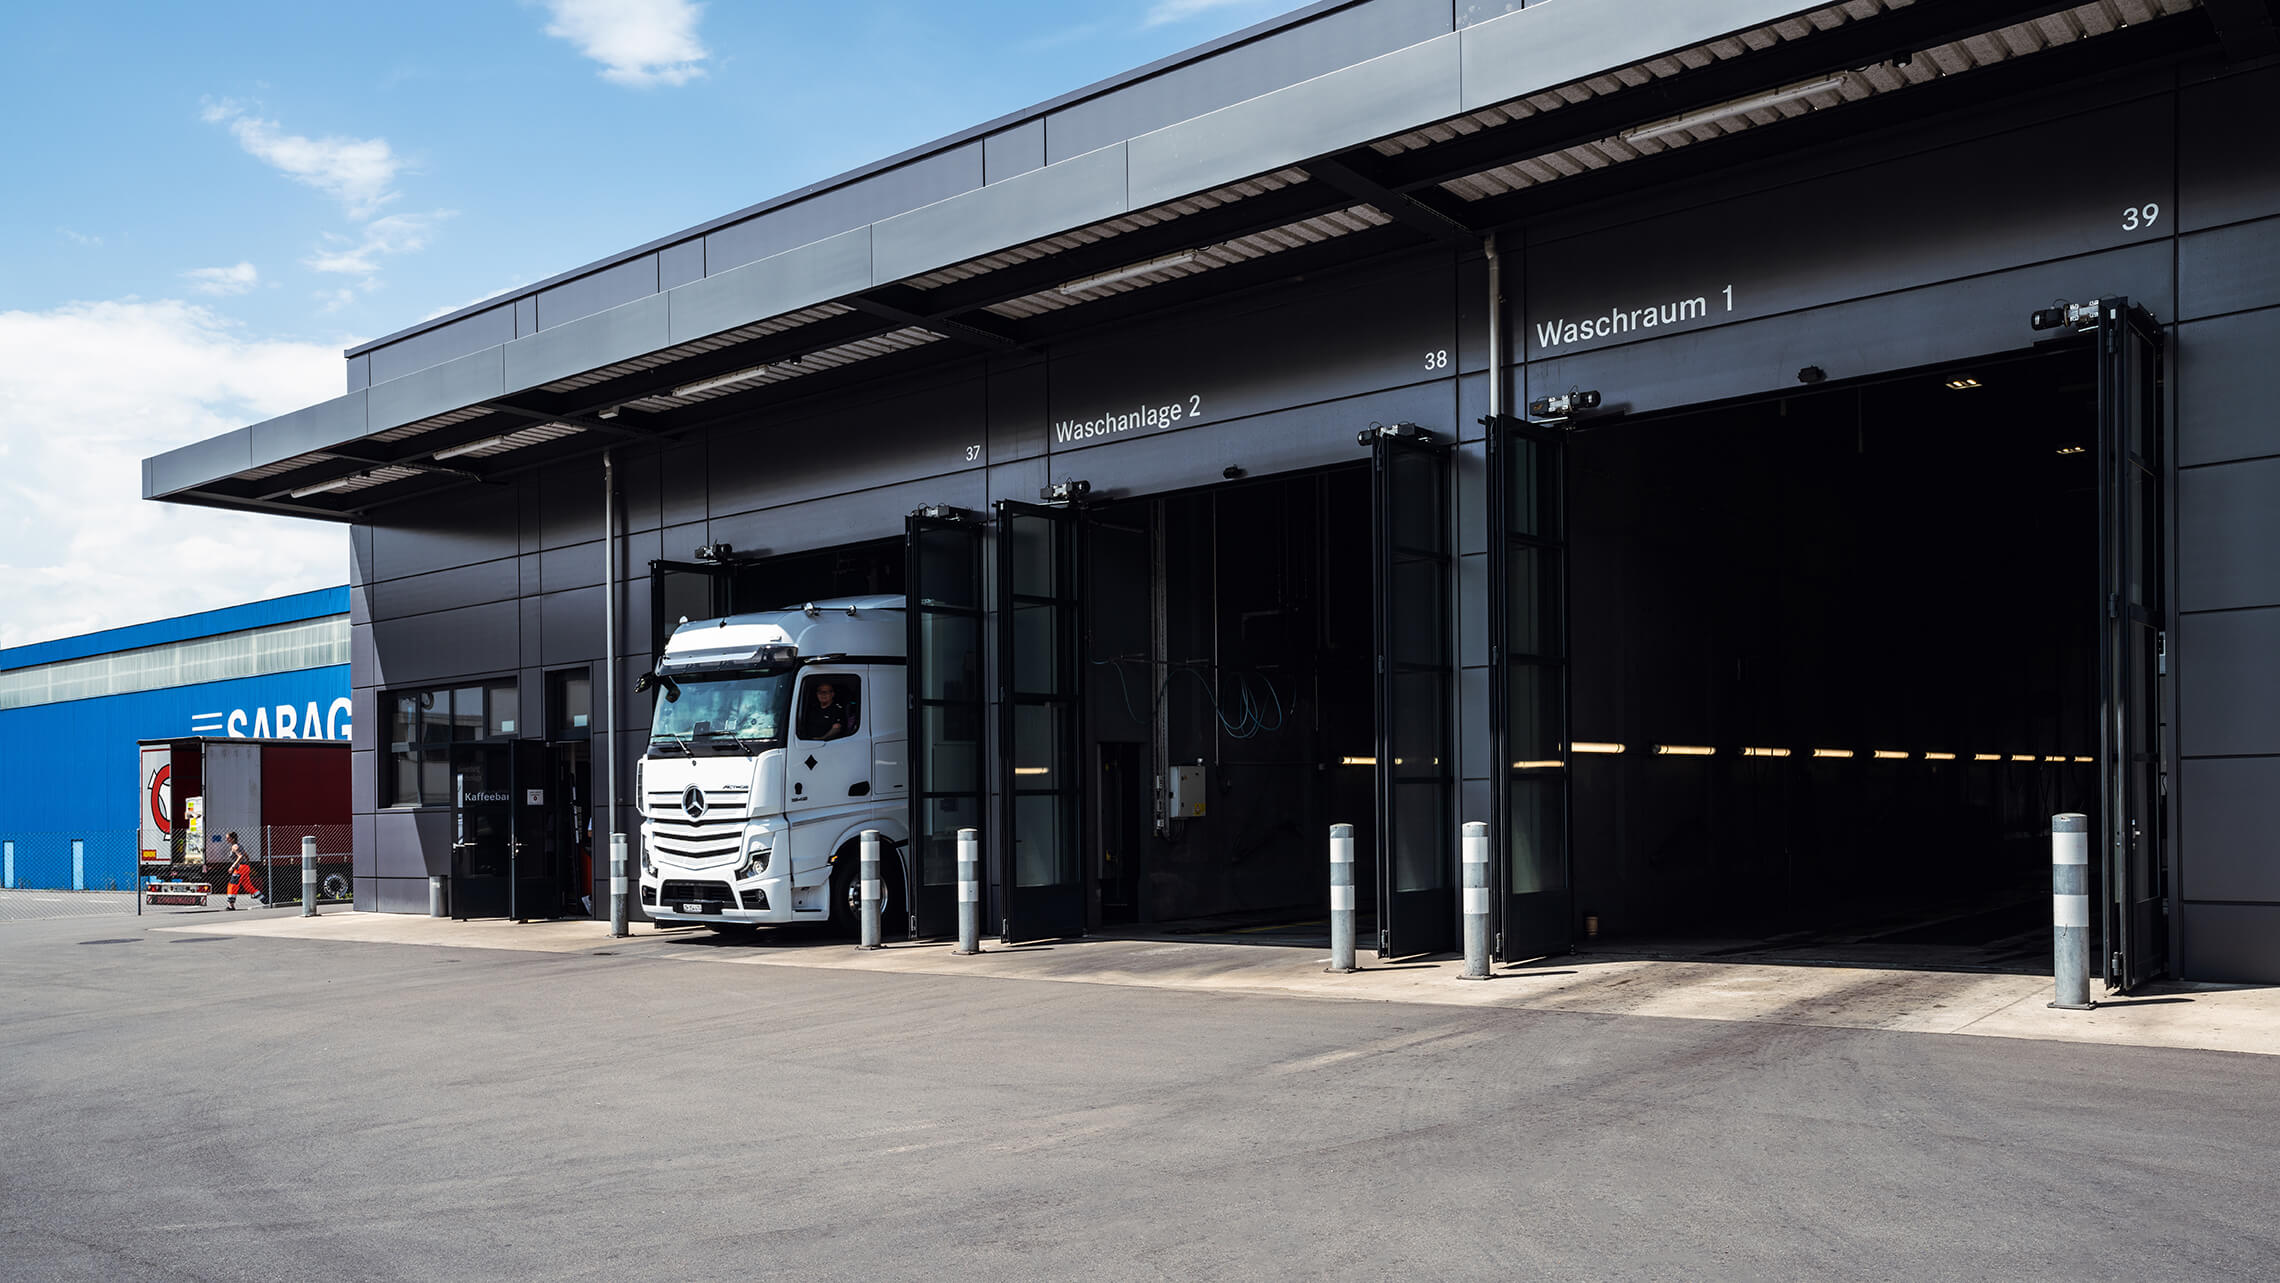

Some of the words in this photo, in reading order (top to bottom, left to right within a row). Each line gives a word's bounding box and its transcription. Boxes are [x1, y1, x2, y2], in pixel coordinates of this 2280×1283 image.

[2122, 203, 2159, 231] 39
[1537, 297, 1706, 348] Waschraum
[1722, 285, 1733, 312] 1
[1425, 350, 1447, 370] 38
[1056, 403, 1182, 443] Waschanlage
[1189, 394, 1201, 417] 2
[966, 445, 980, 461] 37
[227, 697, 352, 740] SABAG
